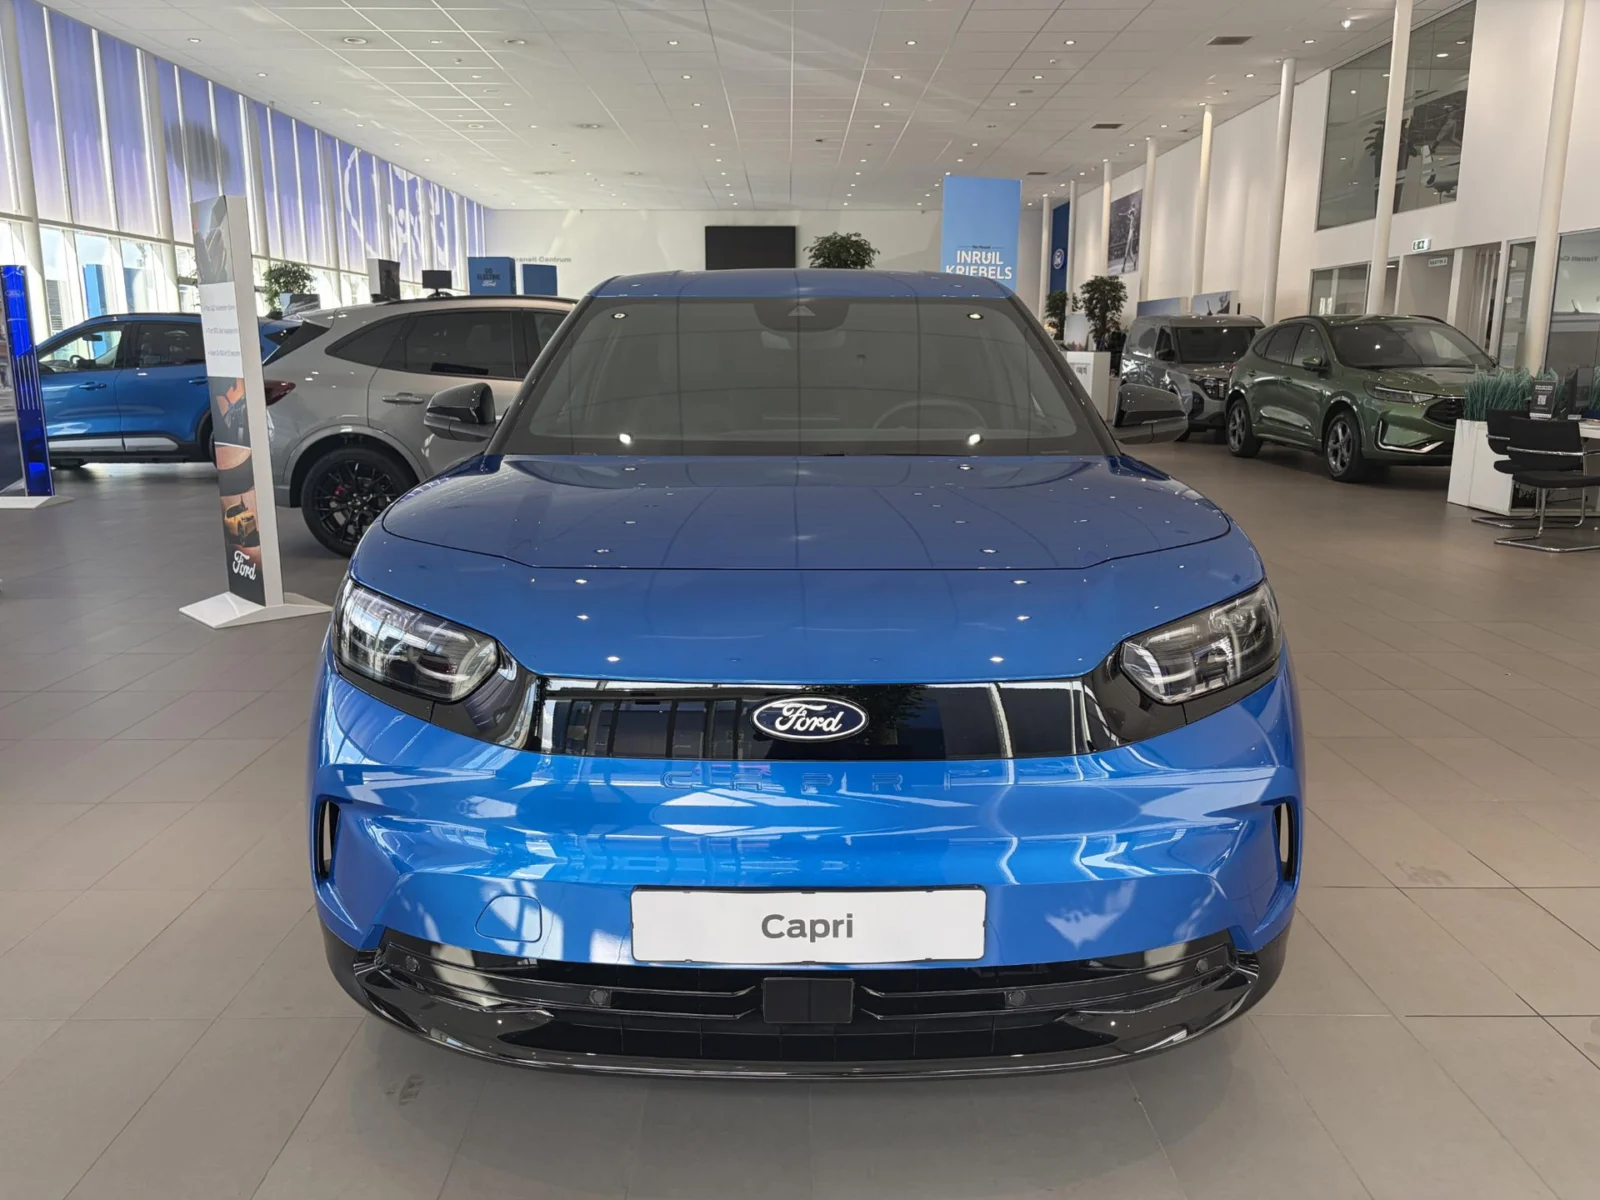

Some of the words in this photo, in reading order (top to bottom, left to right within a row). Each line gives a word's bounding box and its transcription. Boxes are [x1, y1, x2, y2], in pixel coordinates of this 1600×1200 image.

[946, 265, 1013, 280] KRIEBELS
[956, 250, 1004, 265] INRUIL
[232, 550, 256, 580] Ford
[771, 702, 843, 732] Ford
[761, 913, 853, 943] Capri
